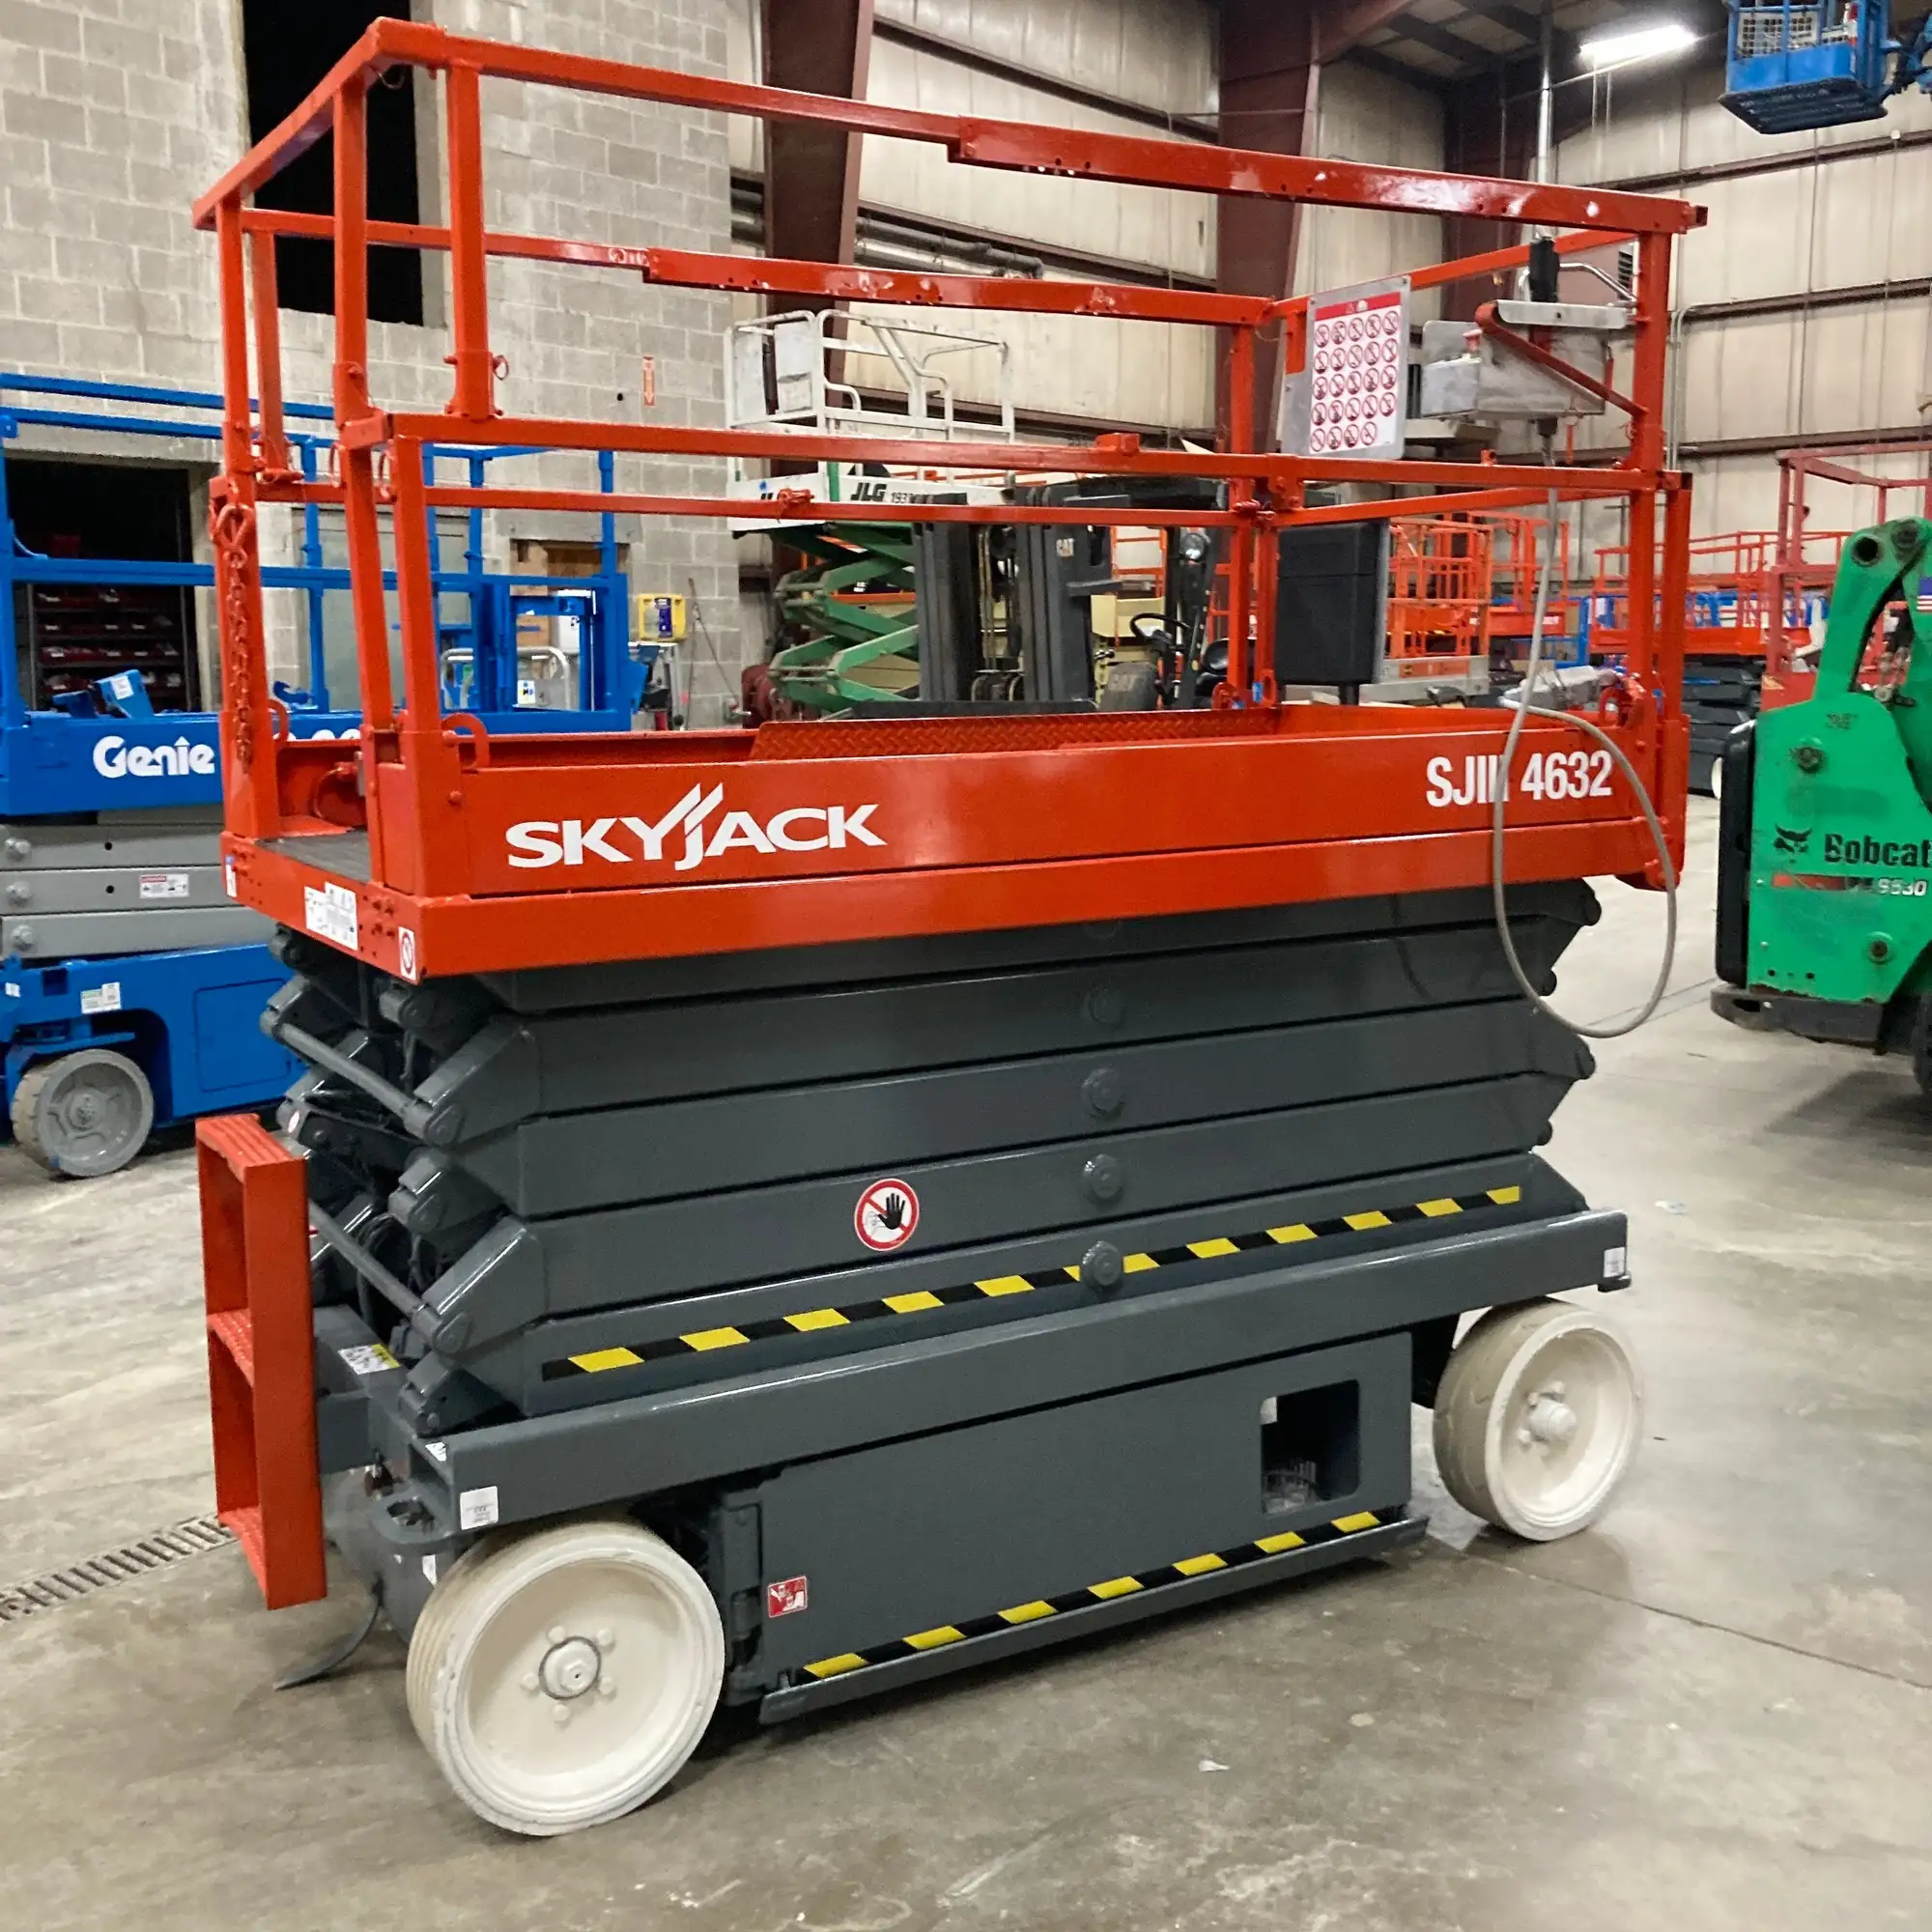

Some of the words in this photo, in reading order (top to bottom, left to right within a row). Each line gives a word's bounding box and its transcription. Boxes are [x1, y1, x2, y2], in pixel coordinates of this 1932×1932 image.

[850, 482, 887, 501] JLG
[93, 735, 215, 779] Genie
[1426, 754, 1510, 808] SJII
[1520, 750, 1613, 801] 4632
[505, 782, 888, 871] SKYJACK
[1824, 833, 1931, 867] Bobcat
